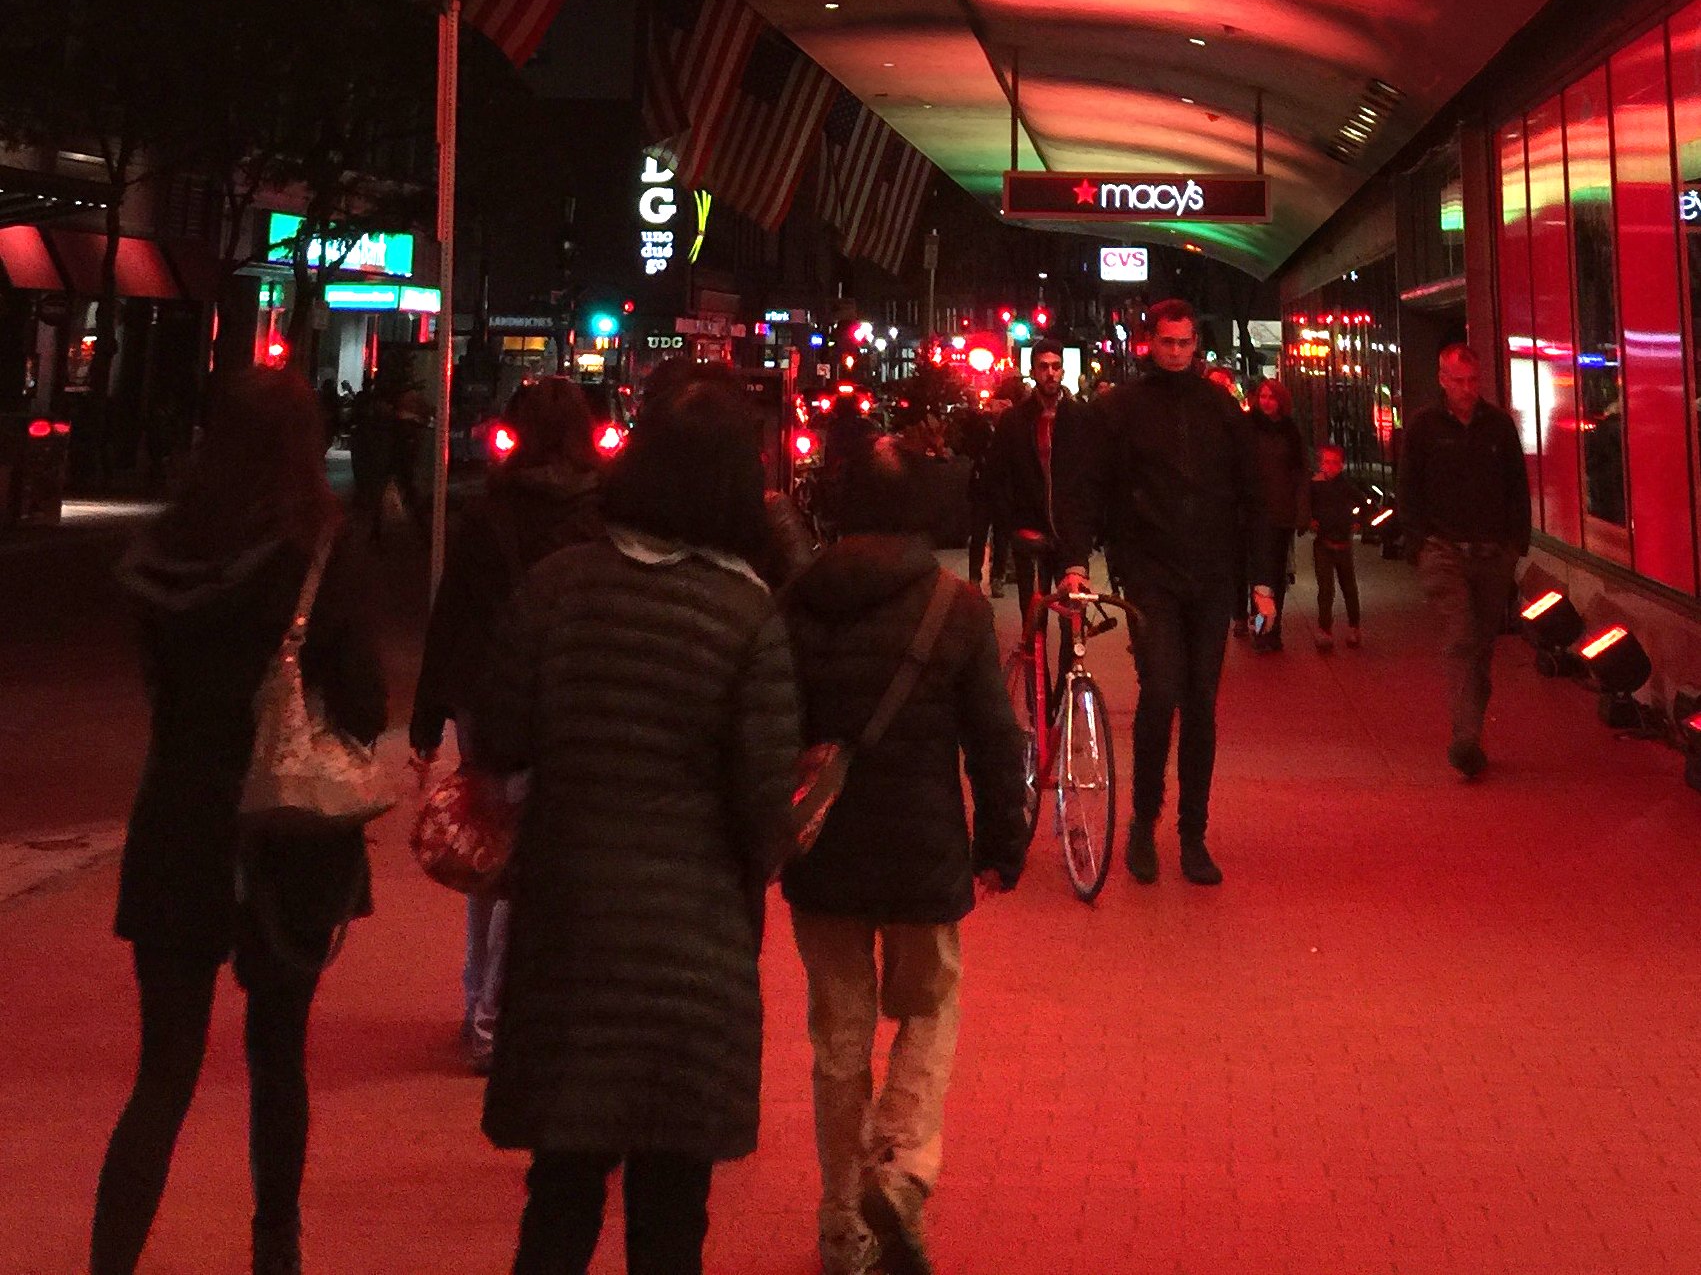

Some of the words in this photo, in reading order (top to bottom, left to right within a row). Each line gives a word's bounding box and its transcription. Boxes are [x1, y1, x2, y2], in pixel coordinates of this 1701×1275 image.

[1101, 180, 1204, 216] macy's
[641, 231, 674, 242] uno
[645, 259, 668, 275] go
[1103, 252, 1146, 268] CVS
[647, 336, 684, 349] UDG
